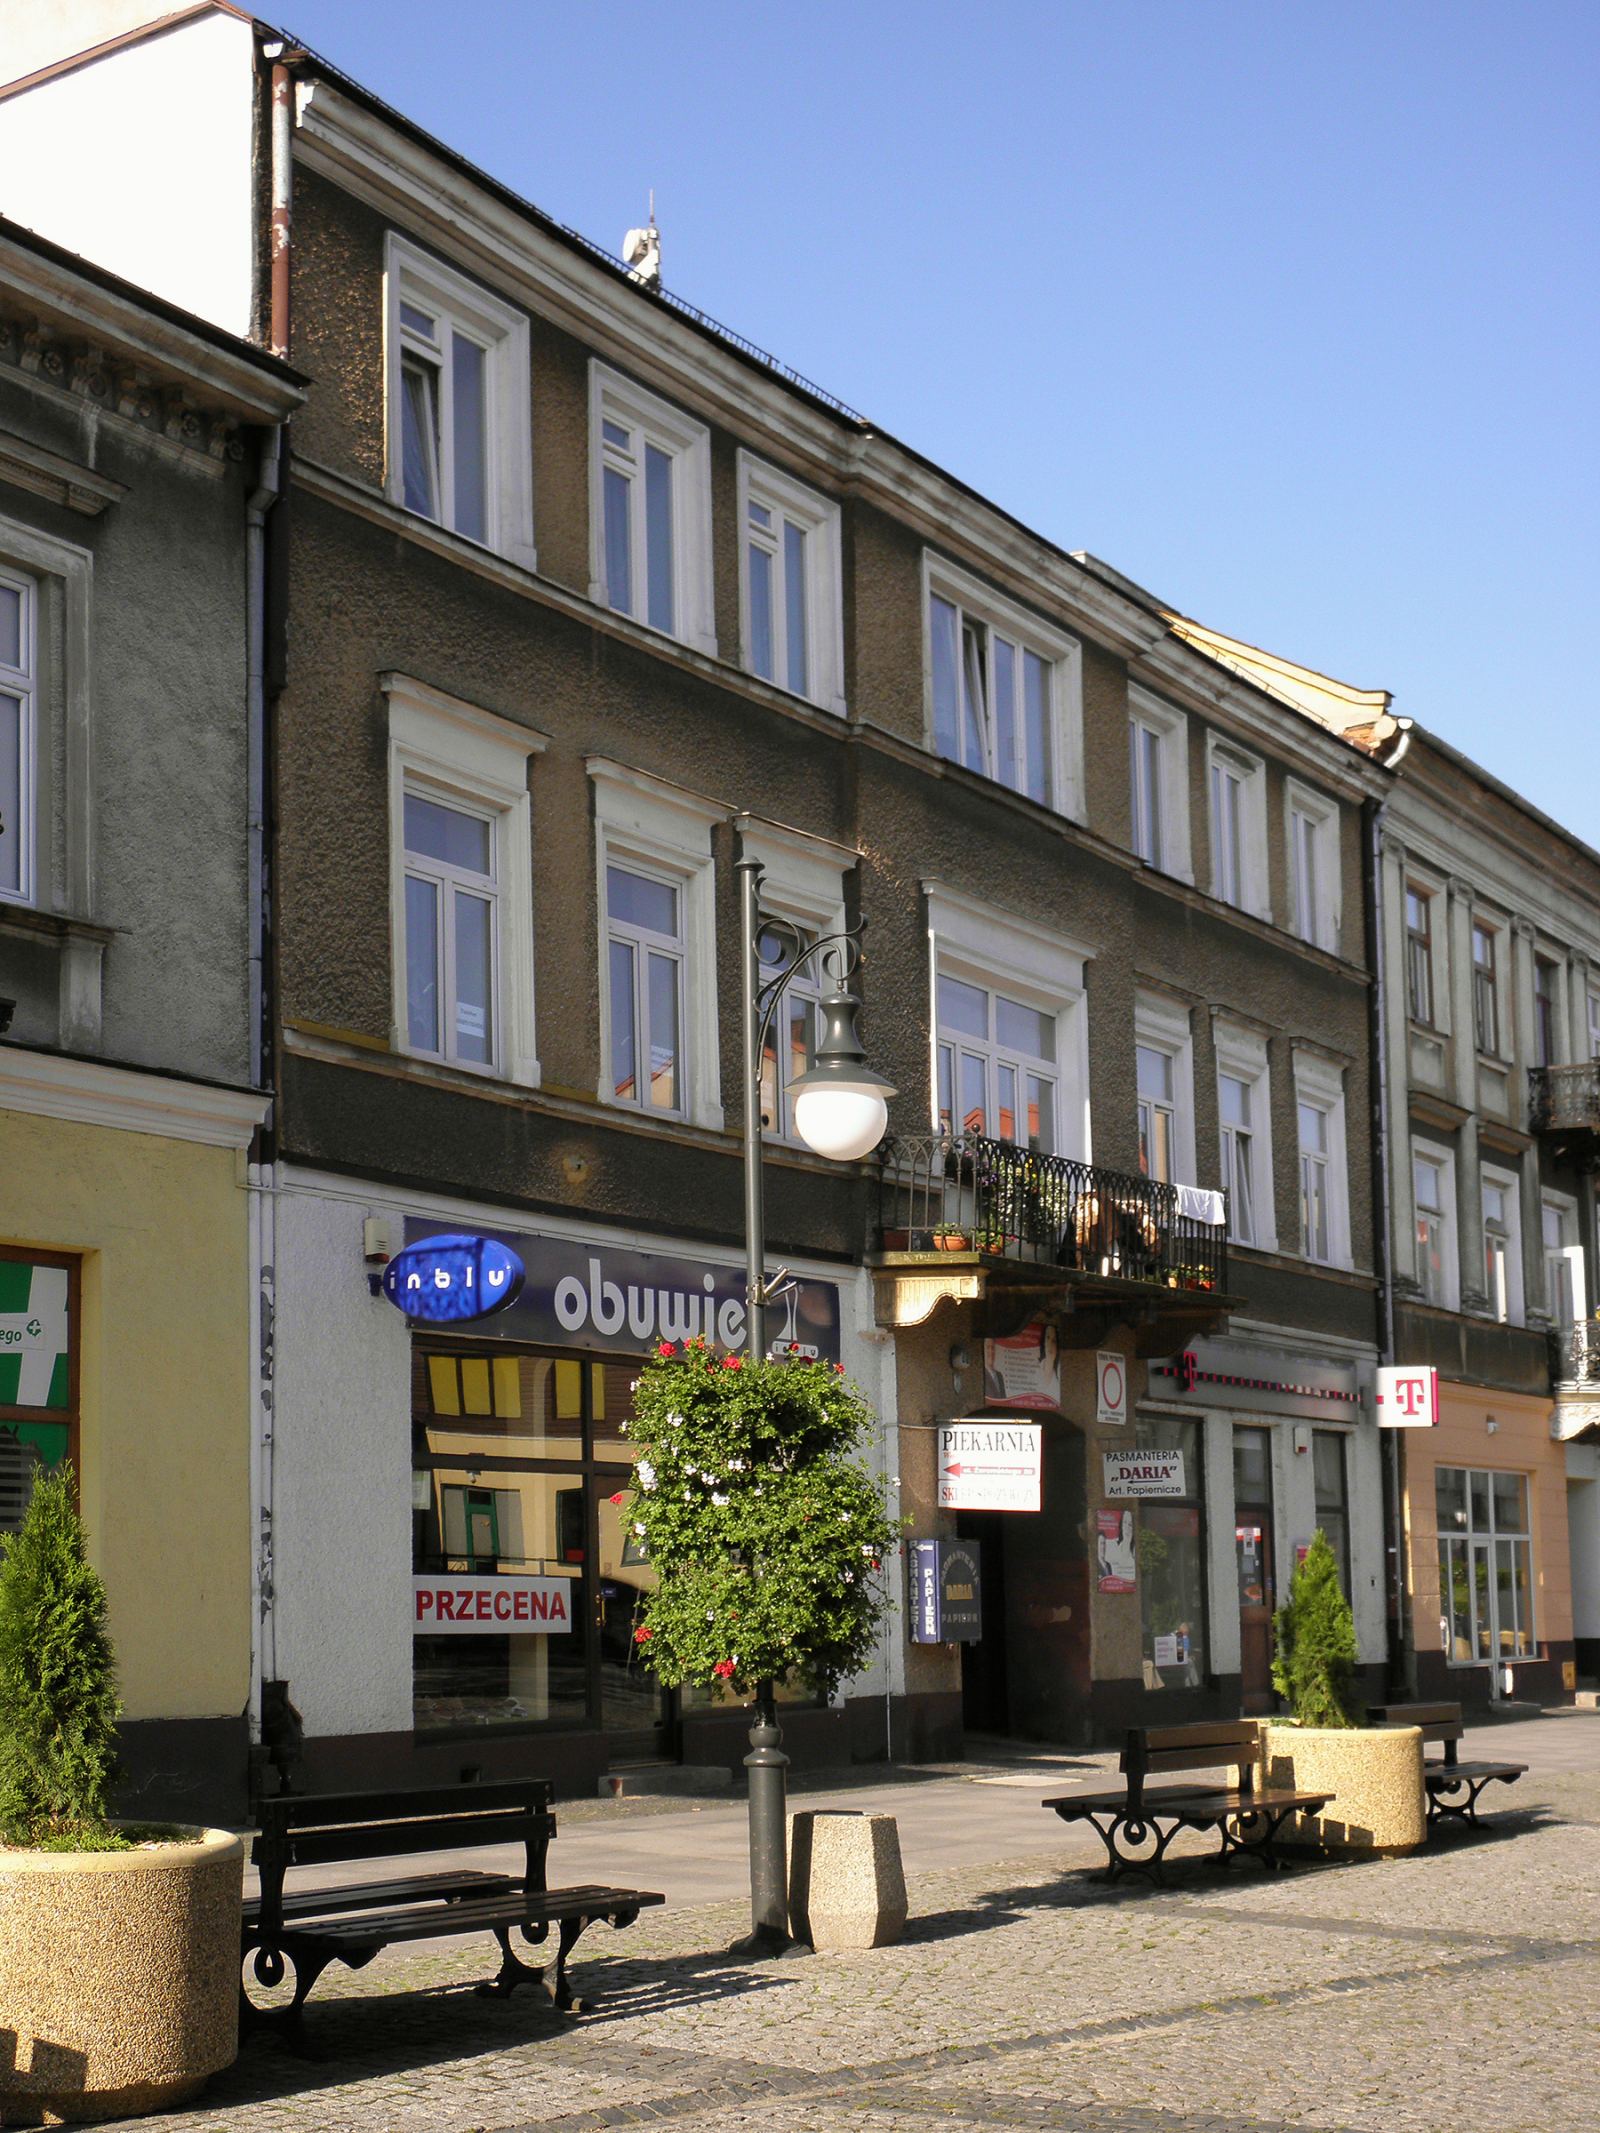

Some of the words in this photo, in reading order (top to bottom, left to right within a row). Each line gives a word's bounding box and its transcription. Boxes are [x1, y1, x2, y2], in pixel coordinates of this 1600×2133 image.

[390, 1266, 504, 1290] inblu
[554, 1258, 747, 1349] obuwie
[1184, 1351, 1198, 1392] T
[1396, 1379, 1424, 1415] T
[942, 1431, 1035, 1452] PIEKARNIA
[1106, 1451, 1180, 1462] PASMANTERIA
[1127, 1486, 1181, 1495] Papiernicze
[416, 1590, 567, 1621] PRZECENA
